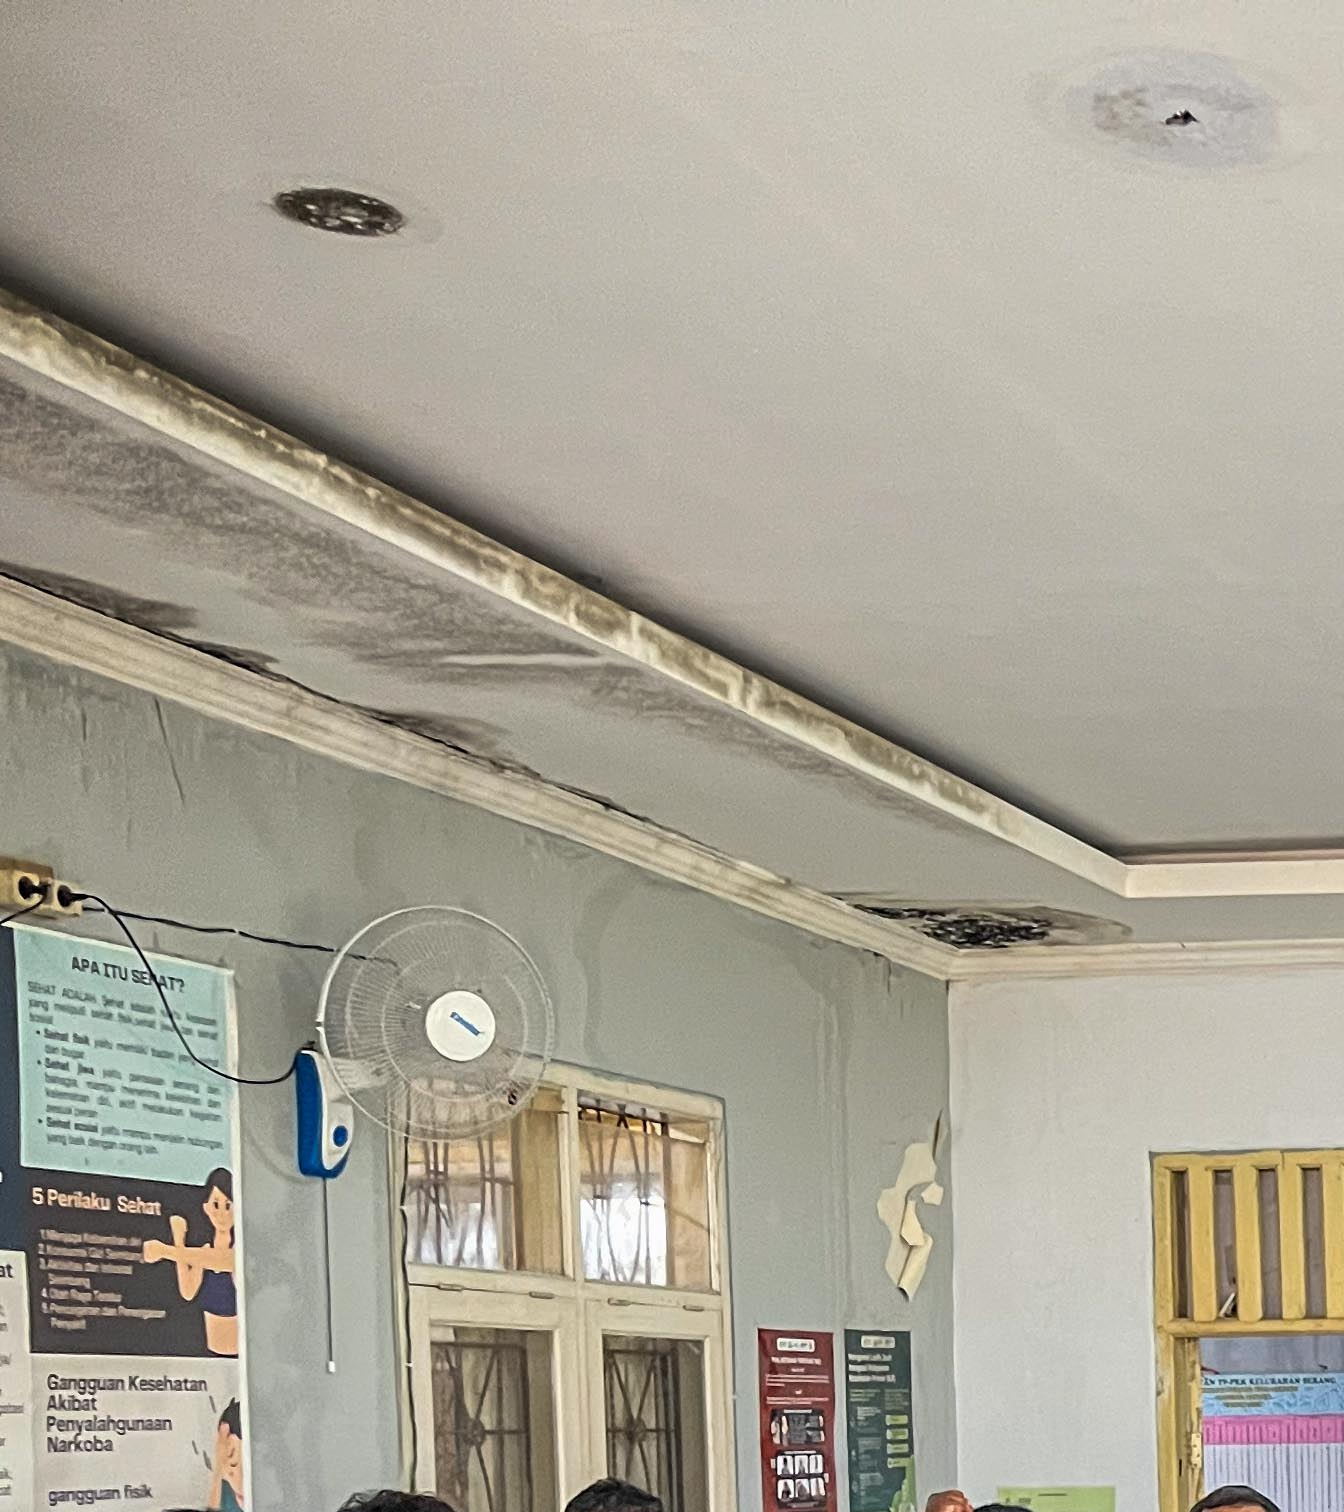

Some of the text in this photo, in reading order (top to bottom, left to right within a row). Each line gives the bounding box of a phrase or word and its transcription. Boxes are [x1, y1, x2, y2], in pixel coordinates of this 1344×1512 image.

[72, 957, 100, 975] APA
[103, 963, 128, 981] ITU
[32, 1187, 162, 1216] 5 Perilaku Sehat
[47, 1374, 208, 1395] Gangguan Kesehatan
[47, 1395, 98, 1412] Akibat
[46, 1415, 173, 1435] Penyalahgunaan
[46, 1435, 114, 1453] Narkoba
[48, 1484, 153, 1506] gangguan fisik
